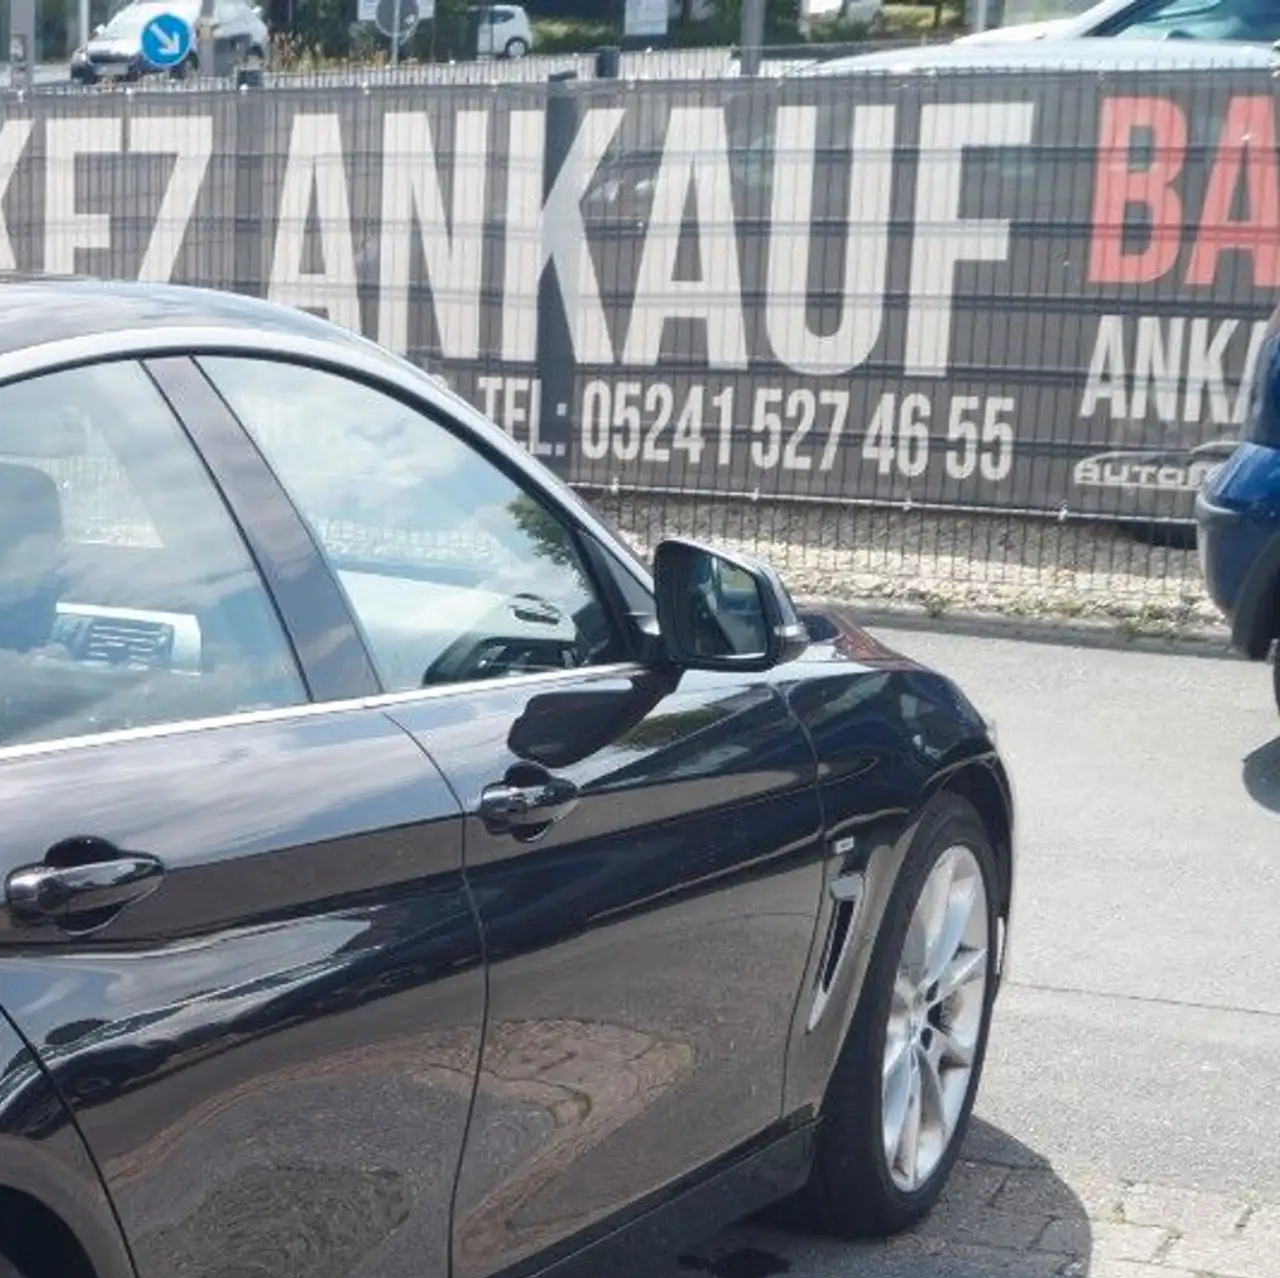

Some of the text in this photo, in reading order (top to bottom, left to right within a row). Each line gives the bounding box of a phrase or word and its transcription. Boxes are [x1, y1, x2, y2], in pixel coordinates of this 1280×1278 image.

[266, 104, 1036, 378] ANKAUF
[477, 376, 1015, 482] TEL: 05241 527 46 55
